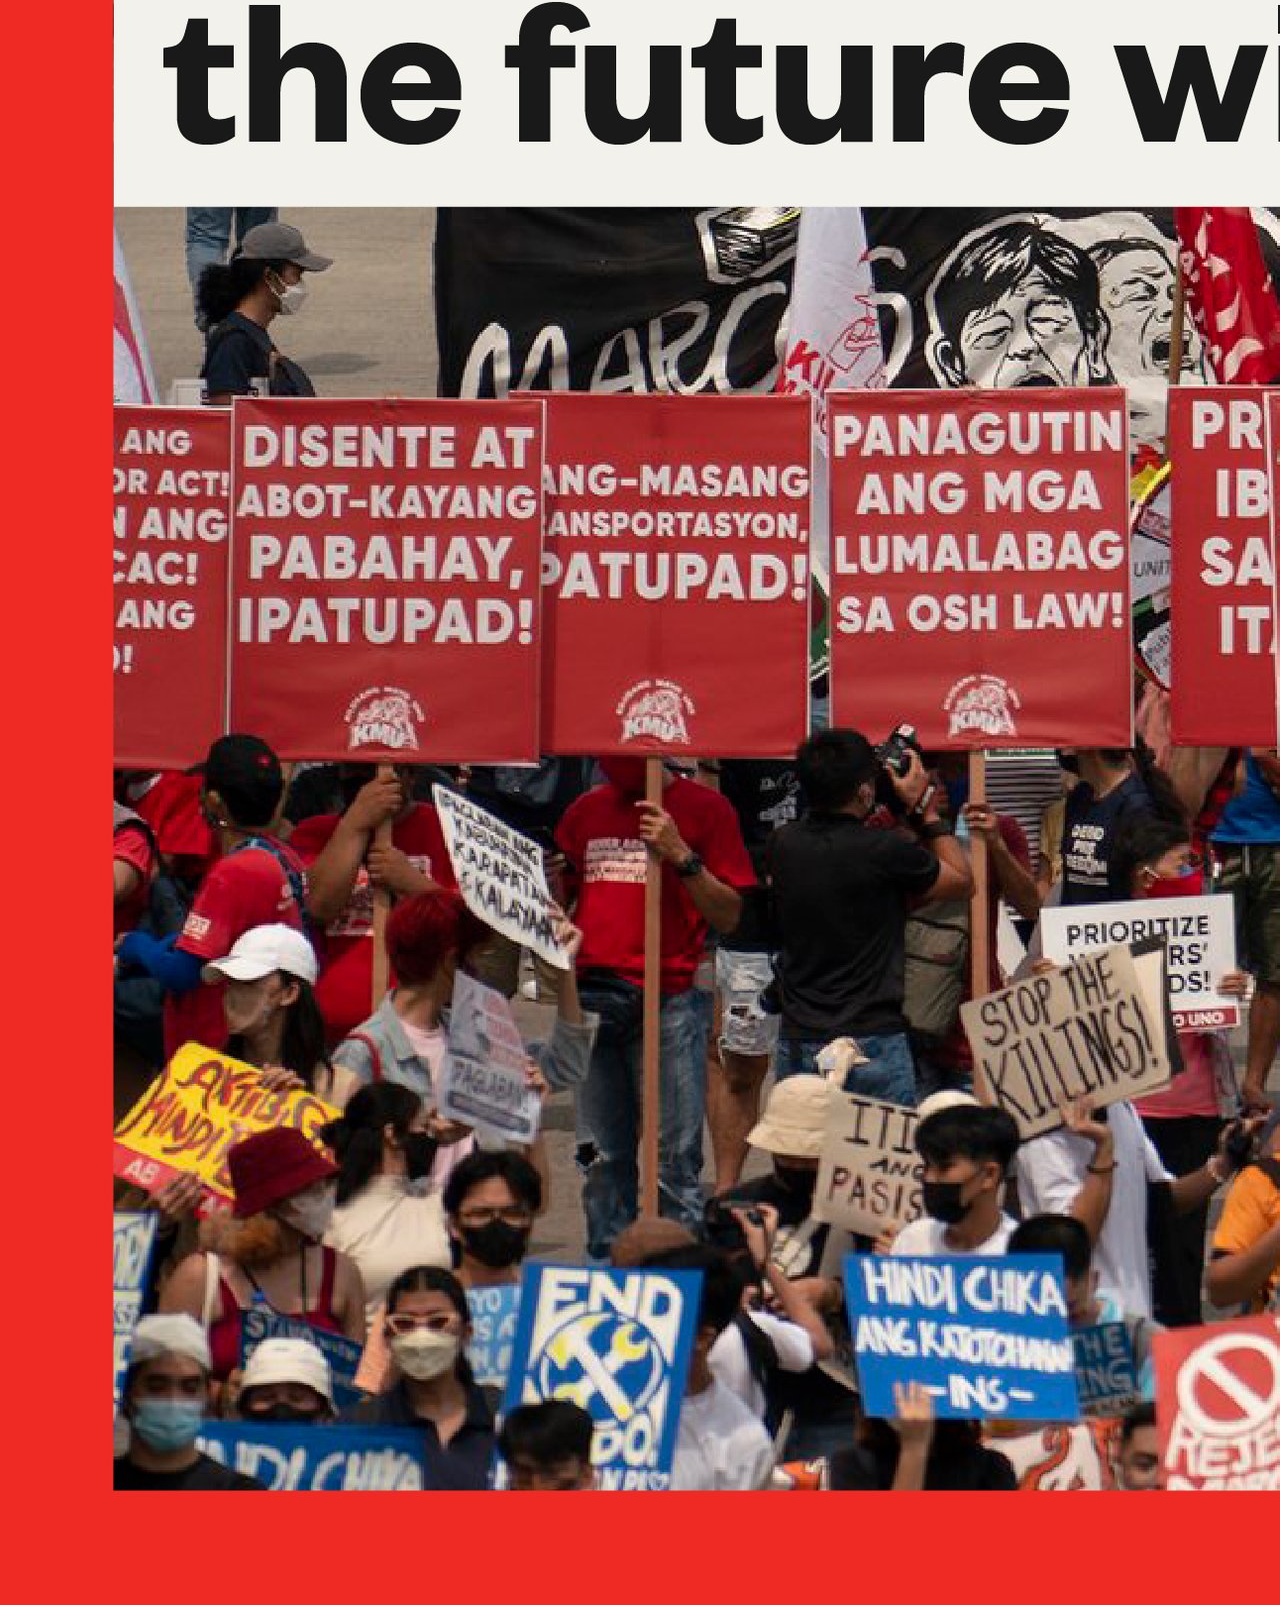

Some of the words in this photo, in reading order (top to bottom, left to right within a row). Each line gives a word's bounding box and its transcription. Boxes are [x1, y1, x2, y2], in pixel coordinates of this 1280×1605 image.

[120, 427, 193, 455] ANG
[243, 425, 457, 470] DISENTE
[468, 426, 534, 469] AT
[834, 410, 1122, 458] PANAGUTIN
[156, 470, 230, 497] ACT!
[236, 485, 537, 520] ABOT-KAYANG
[856, 471, 966, 516] ANG
[984, 470, 1101, 513] MGA
[138, 506, 228, 542] ANG
[544, 510, 807, 543] ANSPORTASYON,
[249, 535, 526, 590] PABAHAY,
[835, 529, 1125, 575] LUMALABAG
[116, 600, 195, 630] ANG
[239, 598, 534, 646] IPATUPAD!
[836, 596, 895, 634] SA
[908, 597, 998, 630] OSH
[1013, 593, 1125, 630] LAW!
[1067, 915, 1209, 946] PRIORITIZE
[980, 980, 1051, 1048] STOP
[1060, 950, 1119, 1007] THE
[1189, 1010, 1225, 1028] UNO
[982, 1004, 1156, 1123] KILLINGS!
[542, 1268, 684, 1344] END
[862, 1260, 959, 1315] HINDI
[963, 1264, 1068, 1316] CHIKA
[855, 1315, 916, 1360] ANG
